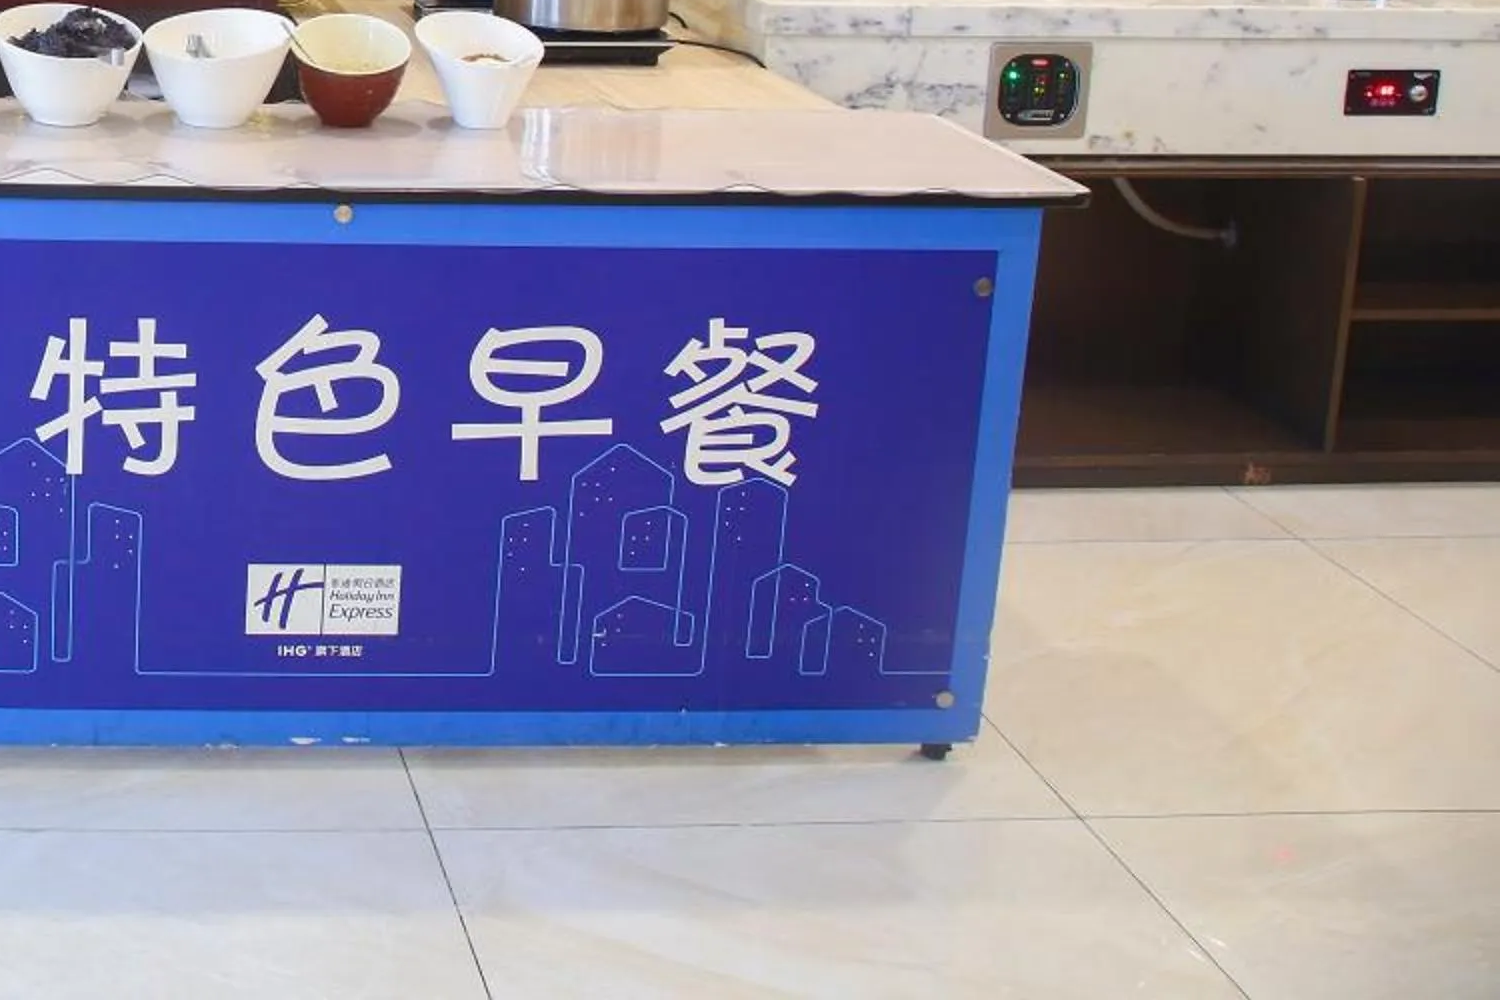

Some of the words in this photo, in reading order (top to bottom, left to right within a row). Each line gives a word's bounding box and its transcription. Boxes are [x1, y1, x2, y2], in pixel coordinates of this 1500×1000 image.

[29, 312, 819, 488] 特色早餐
[328, 603, 394, 622] Express
